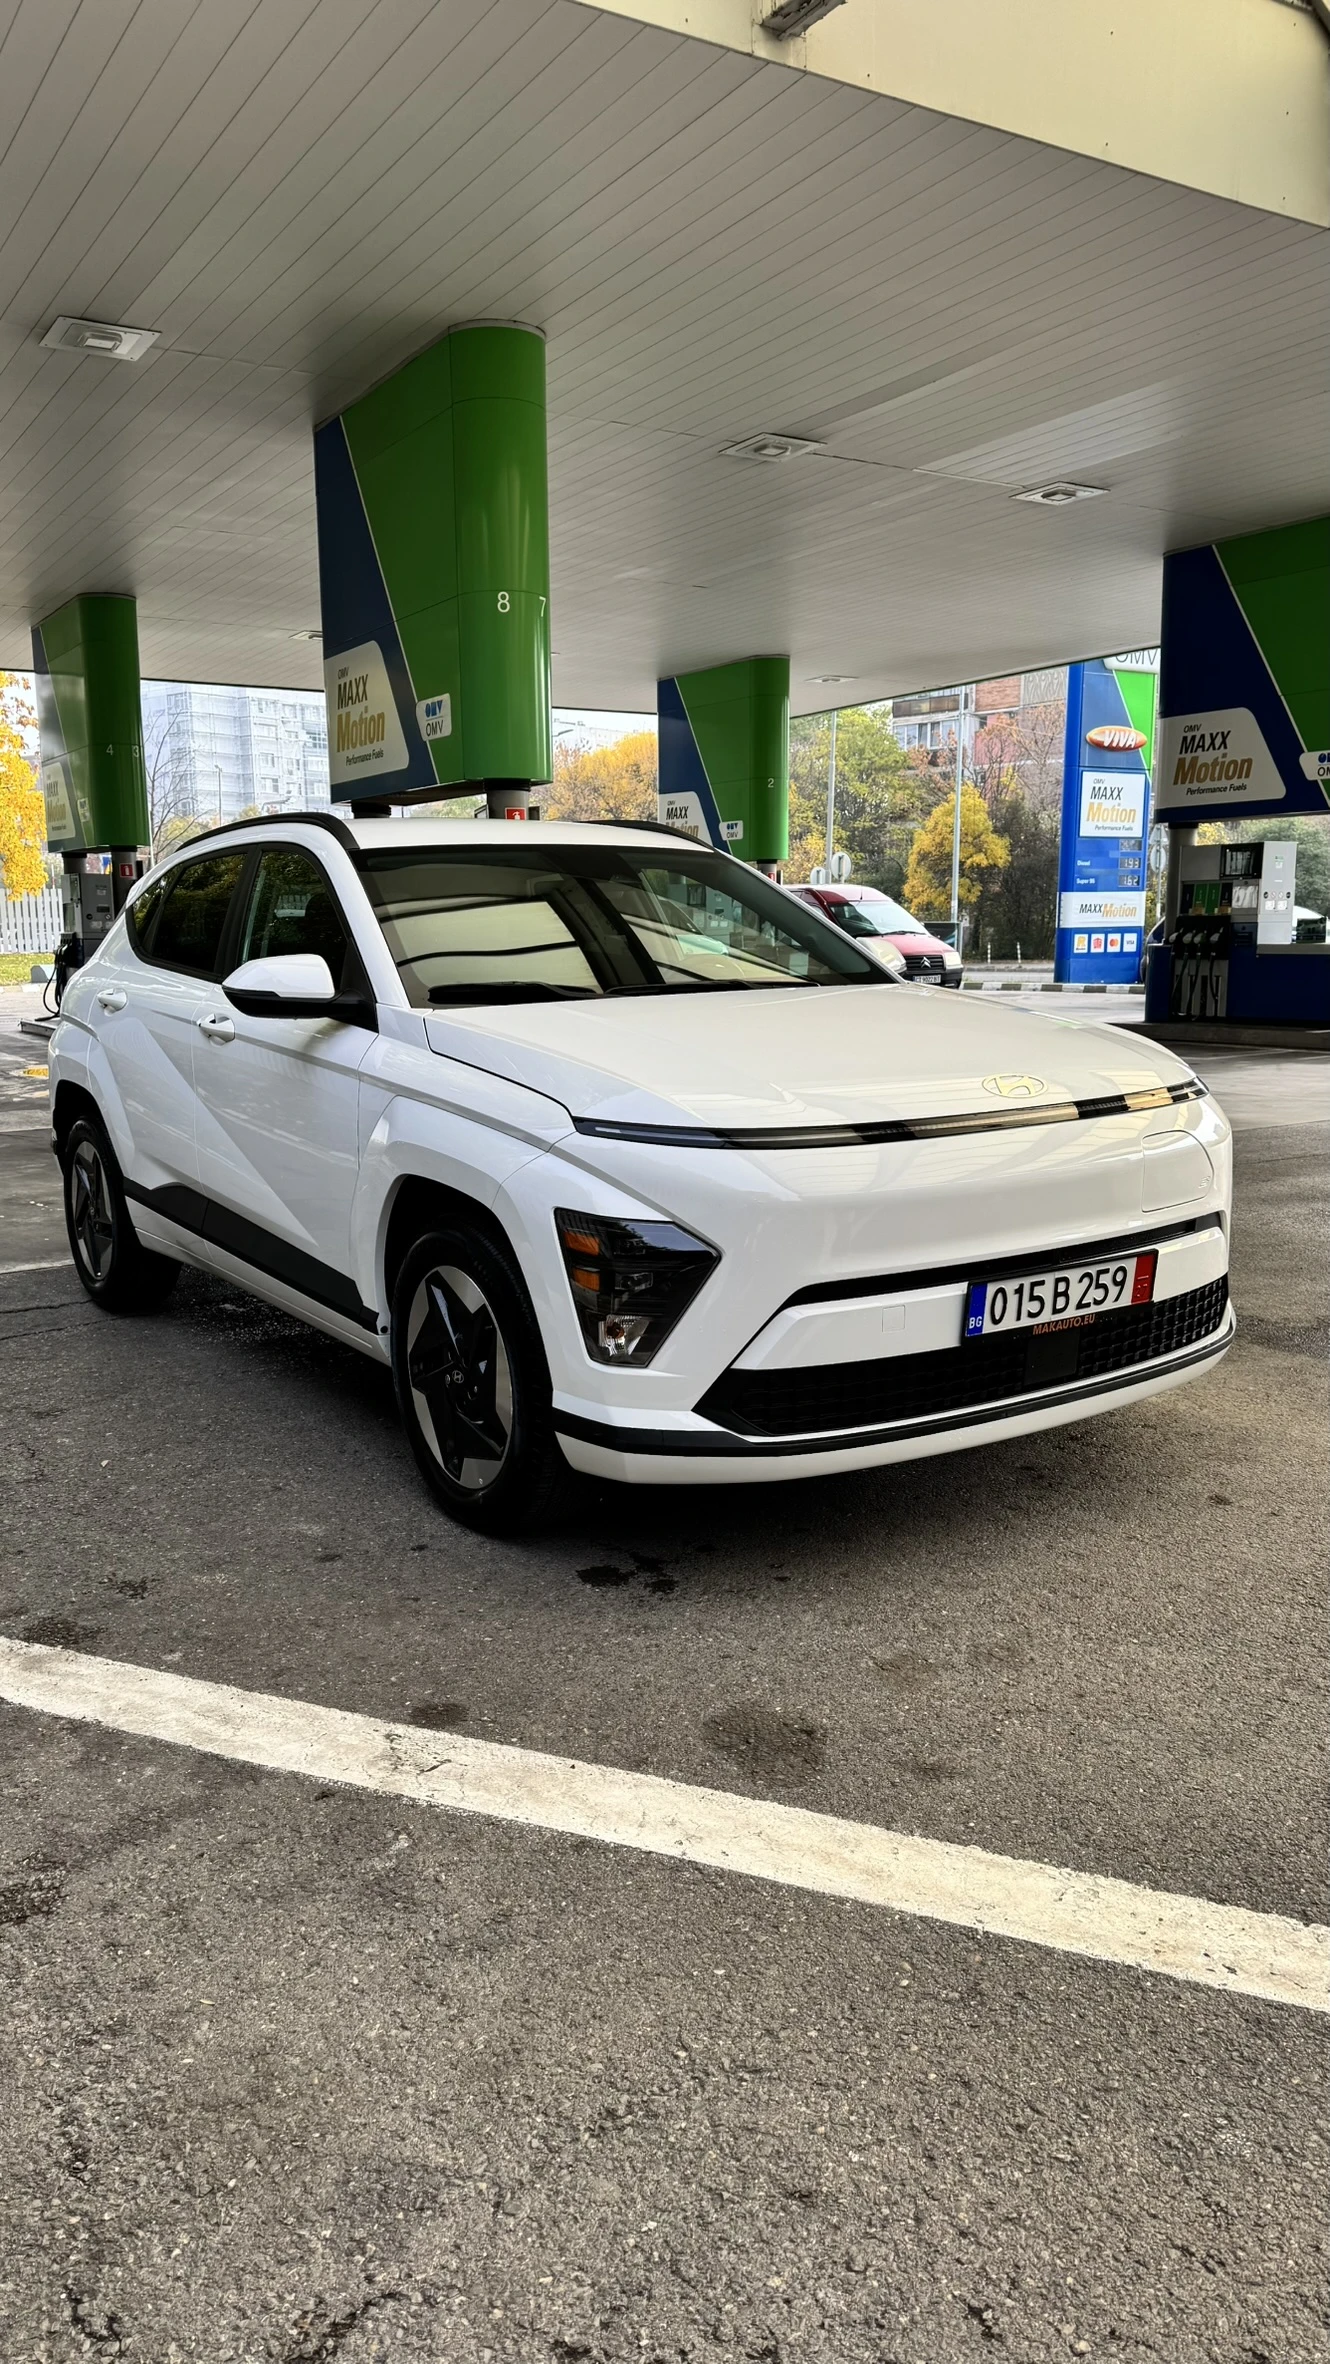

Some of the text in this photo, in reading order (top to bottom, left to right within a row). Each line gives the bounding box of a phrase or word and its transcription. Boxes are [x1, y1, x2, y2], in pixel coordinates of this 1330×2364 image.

[498, 591, 510, 613] 8
[539, 596, 546, 617] 7
[338, 674, 368, 710] MAXX
[337, 706, 385, 752] Motion
[426, 720, 443, 737] OMV
[1184, 724, 1202, 733] OMV
[1103, 730, 1137, 748] VIVA
[1179, 730, 1231, 755] MAXX
[106, 744, 113, 755] 4
[132, 745, 139, 757] 3
[346, 748, 384, 766] Performance Fuels
[1173, 753, 1253, 785] Motion
[768, 778, 774, 788] 2
[1186, 783, 1247, 796] Performance Fuels
[1090, 786, 1123, 800] MAXX
[666, 806, 689, 820] MAXX
[1086, 802, 1136, 823] Motion
[969, 1316, 982, 1329] BG
[1033, 1314, 1096, 1335] MAKAUTO.EU
